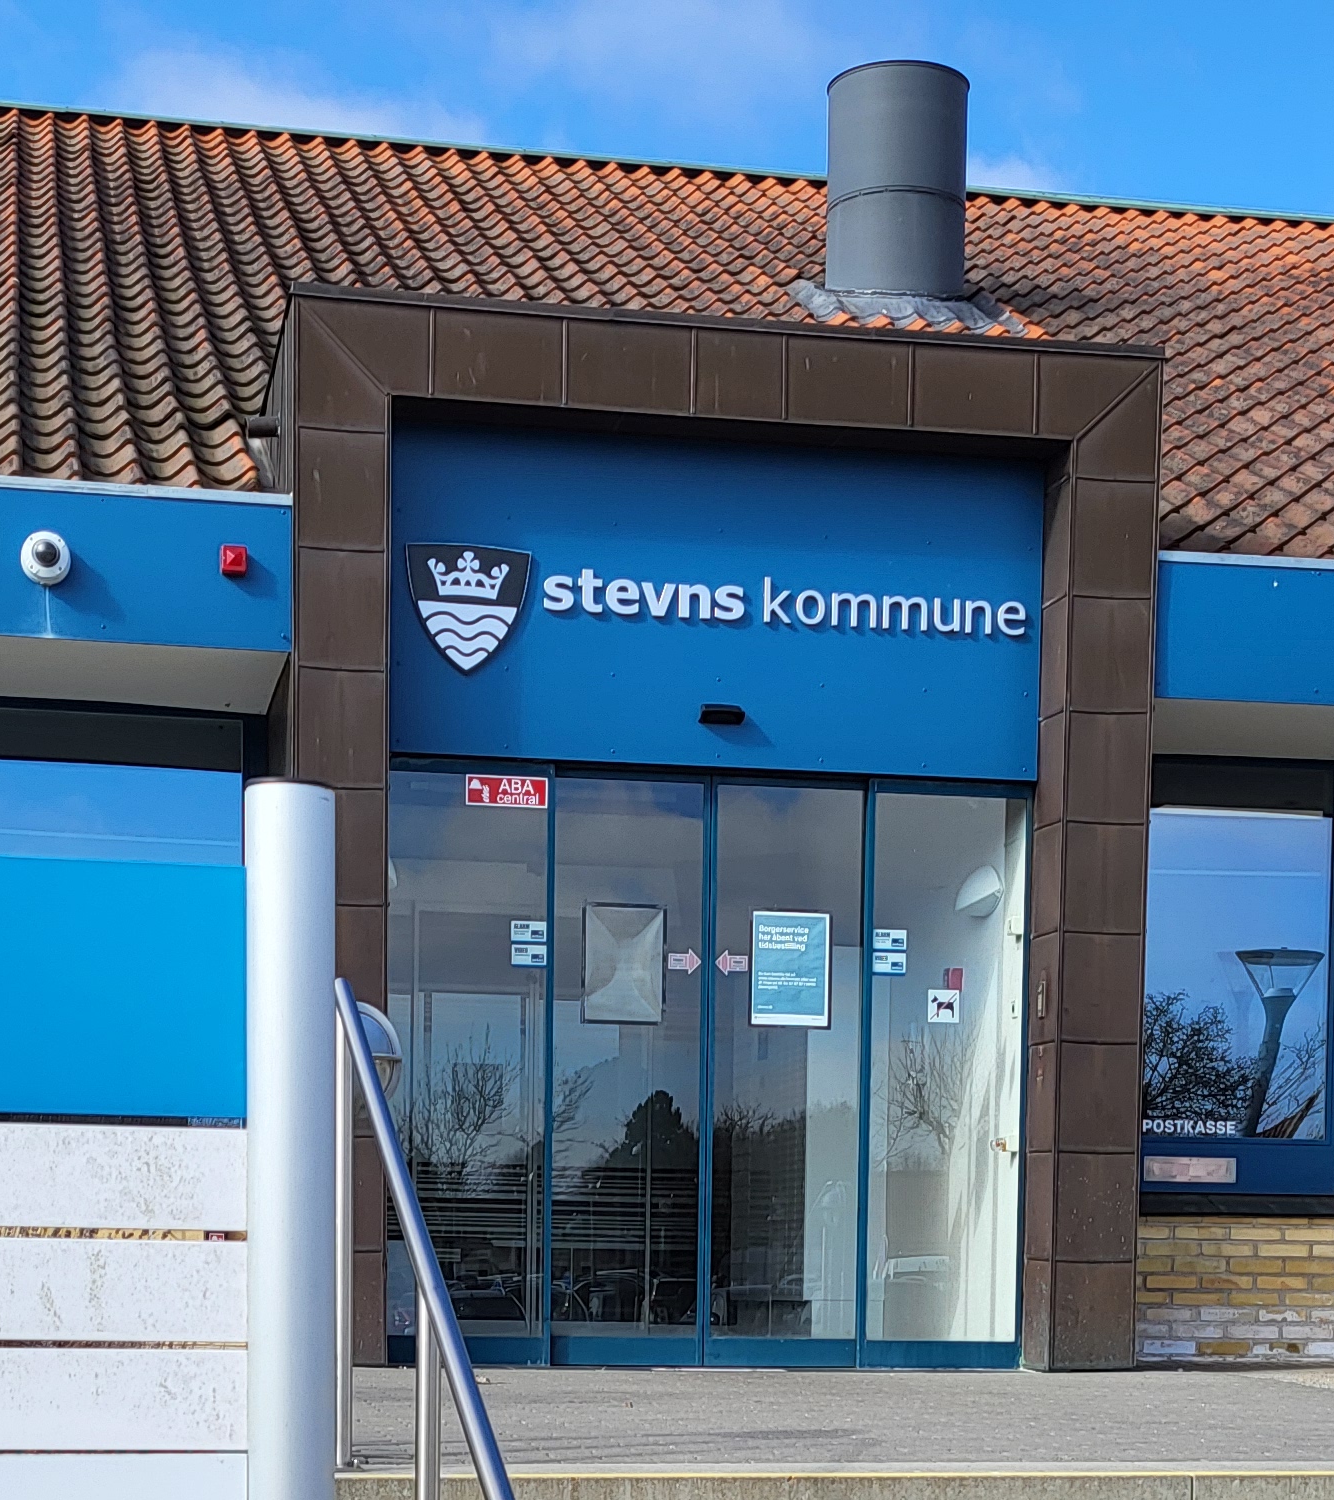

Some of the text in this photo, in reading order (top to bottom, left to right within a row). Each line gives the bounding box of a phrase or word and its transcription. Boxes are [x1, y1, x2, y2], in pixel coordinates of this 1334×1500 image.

[543, 568, 1026, 635] stevns kommune
[499, 779, 534, 794] ABA
[496, 793, 539, 805] central
[1142, 1119, 1236, 1134] POSTKASSE
